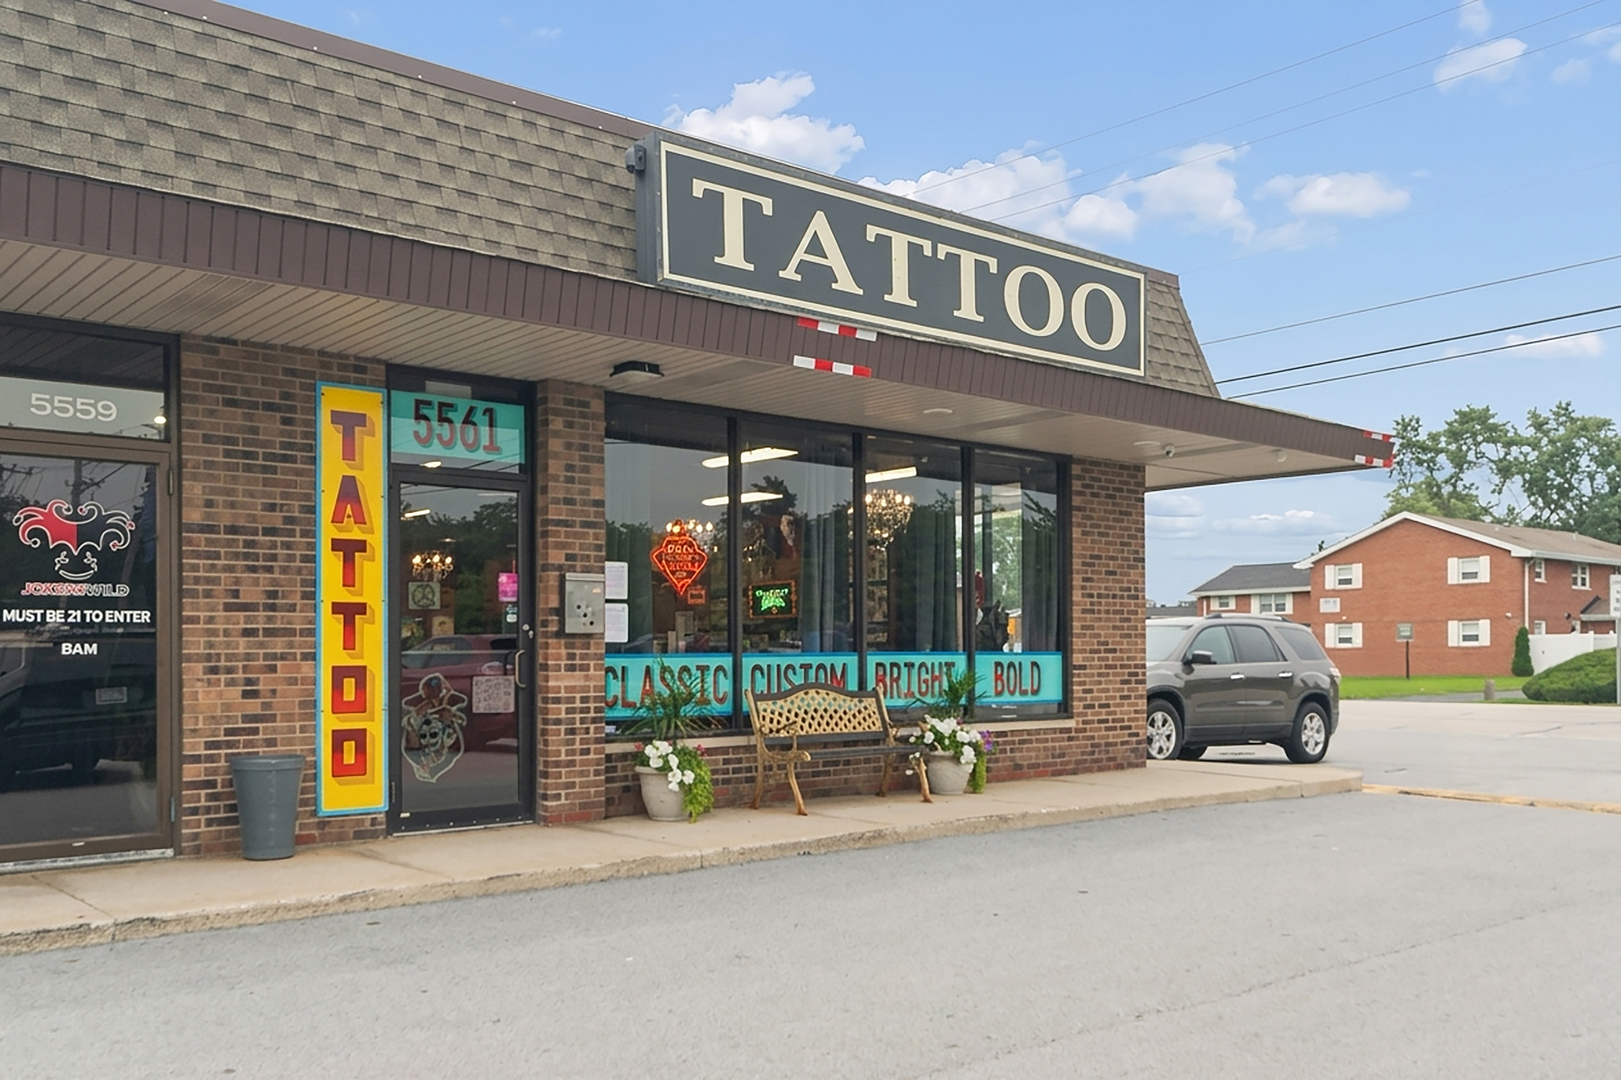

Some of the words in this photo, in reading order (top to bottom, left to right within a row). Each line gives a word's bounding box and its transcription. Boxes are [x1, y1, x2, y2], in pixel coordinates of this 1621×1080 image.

[691, 177, 1127, 351] TATTOO
[30, 392, 117, 422] 5559
[412, 398, 502, 453] 5561
[330, 409, 367, 777] TATTOO
[2, 609, 44, 623] MUST
[46, 610, 65, 622] BE
[67, 610, 81, 622] 21
[84, 610, 103, 622] TO
[105, 610, 151, 623] ENTER
[61, 643, 98, 655] BAM
[605, 664, 729, 708] CLASSIC
[751, 662, 848, 696] CUSTOM
[994, 660, 1042, 696] BOLD
